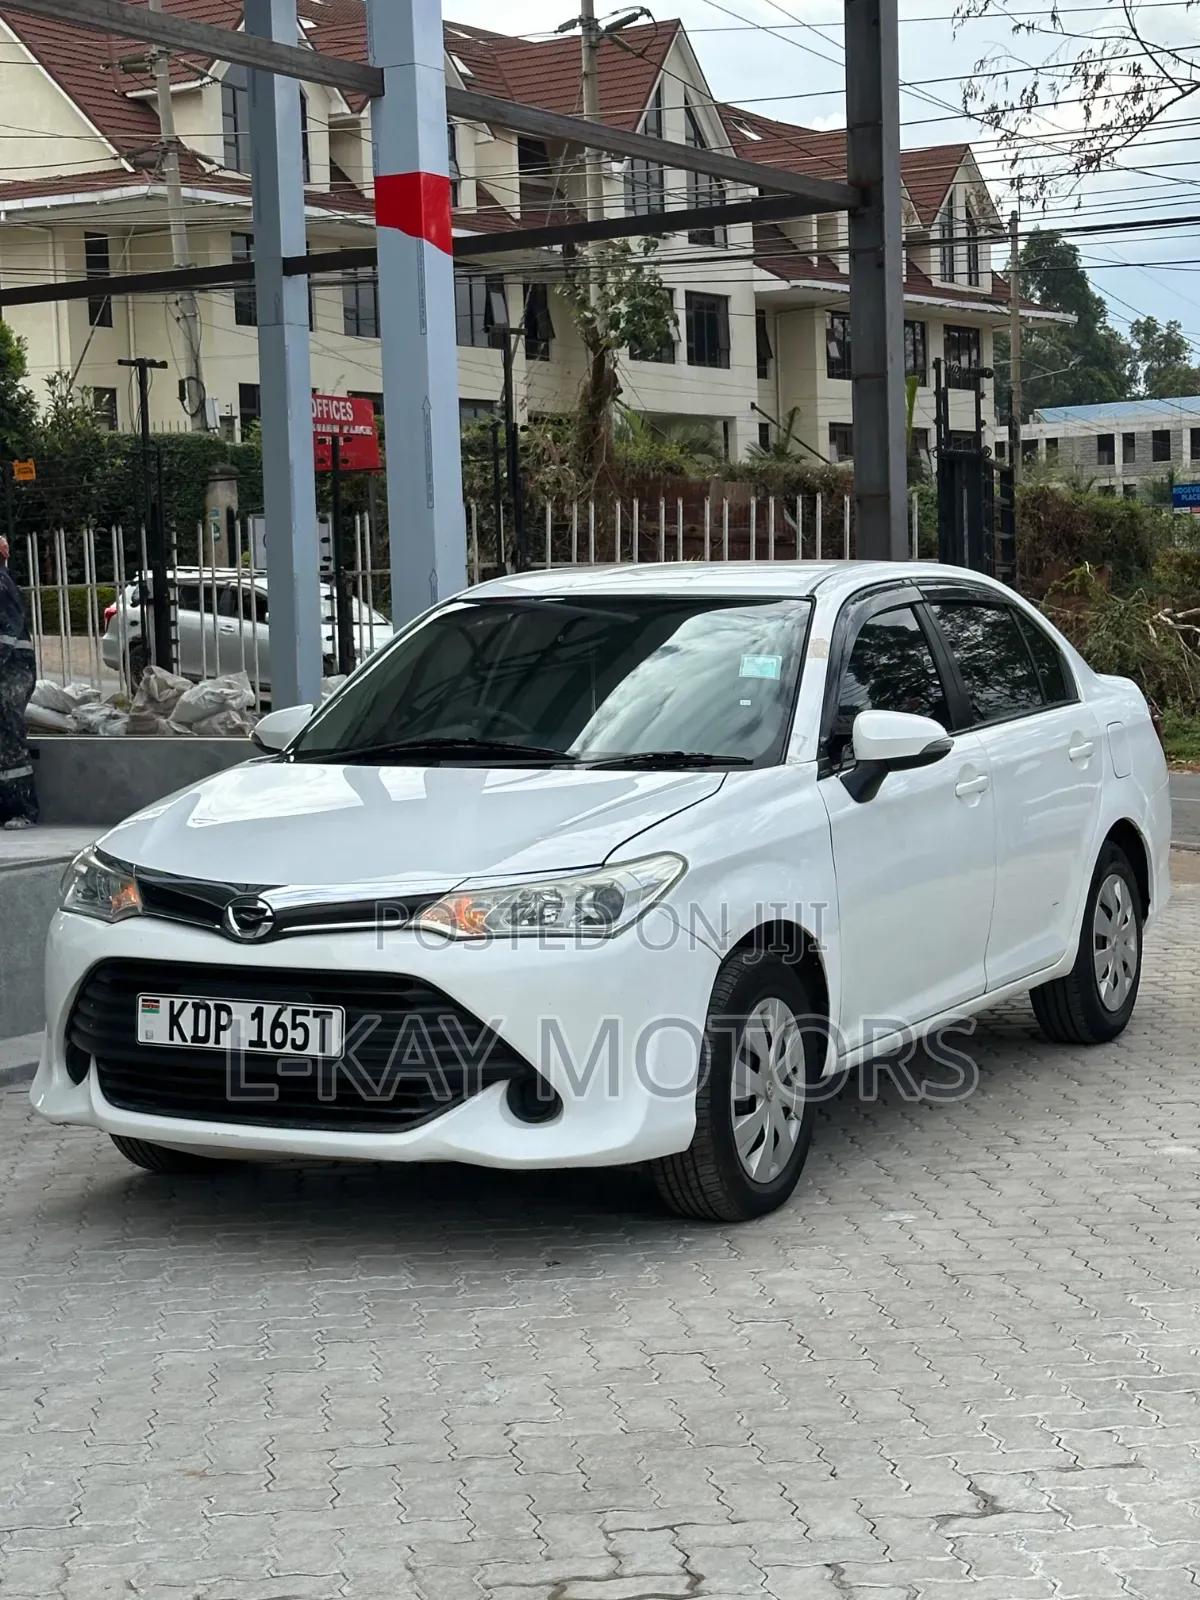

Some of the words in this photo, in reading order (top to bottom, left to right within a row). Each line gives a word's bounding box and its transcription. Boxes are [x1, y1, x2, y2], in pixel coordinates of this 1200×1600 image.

[311, 398, 354, 421] OFFICES
[168, 1000, 234, 1045] KDP
[248, 1006, 334, 1054] 165T
